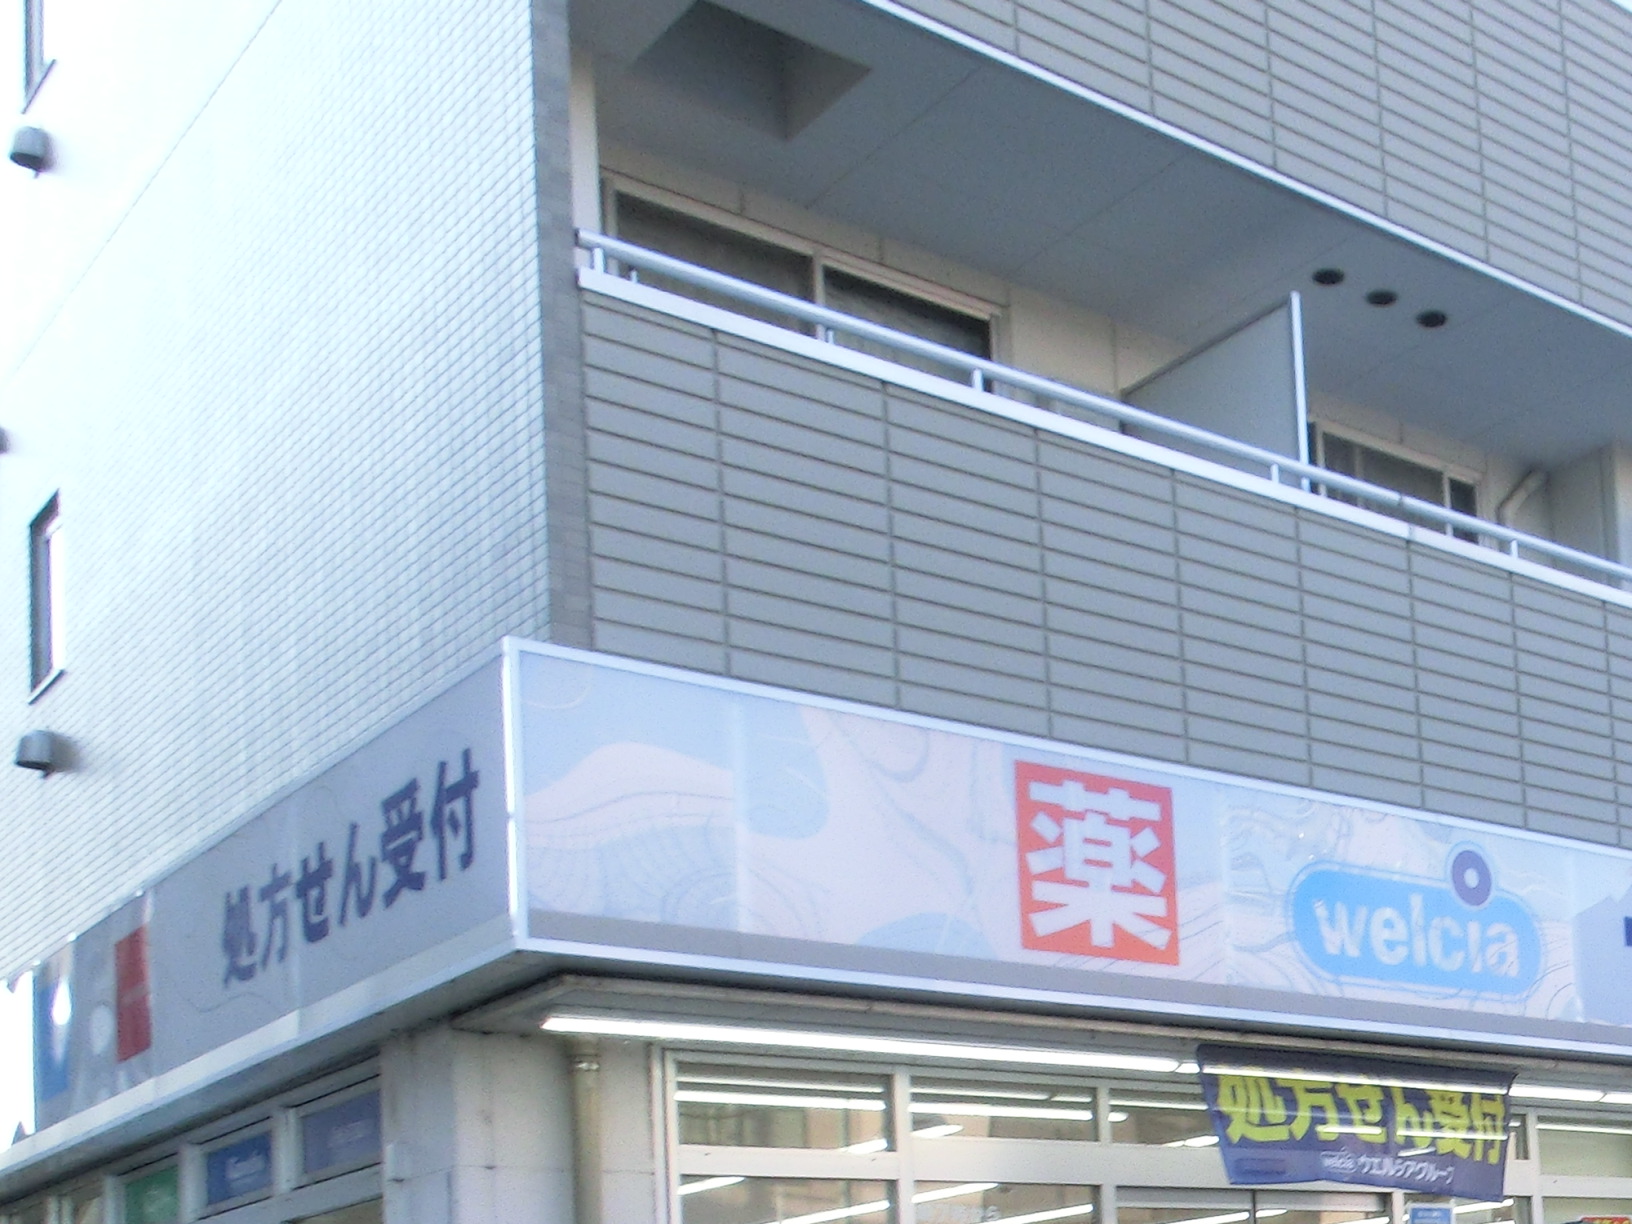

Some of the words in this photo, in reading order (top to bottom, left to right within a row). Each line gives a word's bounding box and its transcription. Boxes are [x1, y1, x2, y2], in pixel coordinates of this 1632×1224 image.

[223, 748, 479, 988] 処方せん受付
[1026, 780, 1173, 951] 薬
[1313, 850, 1520, 978] welcia
[1218, 1075, 1506, 1165] 処方せん受付
